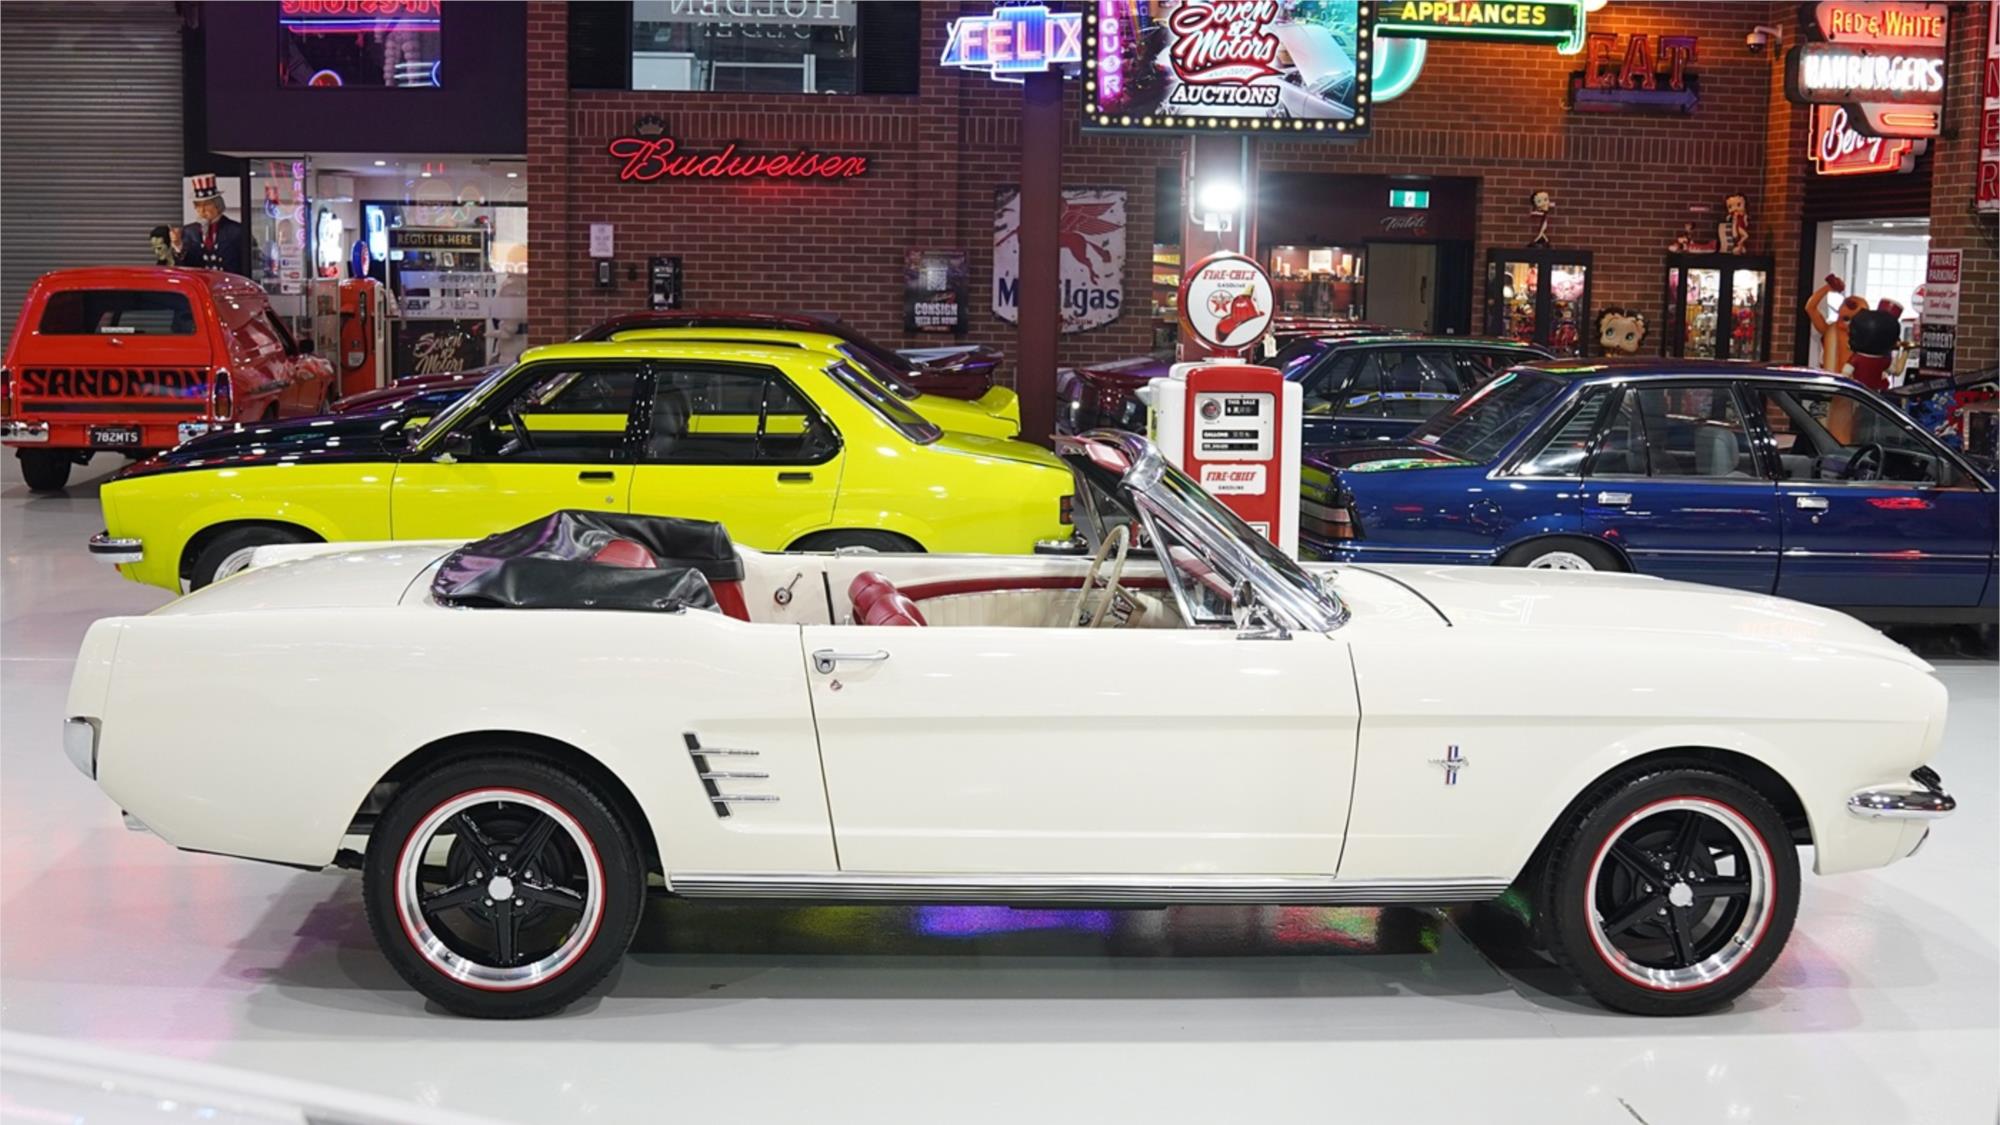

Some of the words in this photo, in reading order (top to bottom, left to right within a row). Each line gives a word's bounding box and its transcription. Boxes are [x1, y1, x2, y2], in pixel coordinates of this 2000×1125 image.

[1400, 3, 1546, 25] APPLIANCES
[1832, 9, 1865, 33] RED
[1868, 16, 1880, 37] &
[1885, 11, 1941, 37] WHITE
[960, 19, 1081, 62] FELIX
[1175, 28, 1275, 69] Motors
[1584, 33, 1697, 90] EAT
[1804, 54, 1943, 92] HAMBURGERS
[1171, 85, 1278, 105] AUCTIONS
[610, 138, 866, 180] Budweiser
[398, 234, 443, 245] REGISTER
[448, 234, 472, 245] HERE
[1930, 254, 1958, 267] PRIVATE
[915, 303, 958, 316] CONSIGN
[21, 369, 208, 397] SANDMAN
[95, 431, 138, 443] 782MTS
[1206, 471, 1257, 482] FIRE-CHIEF
